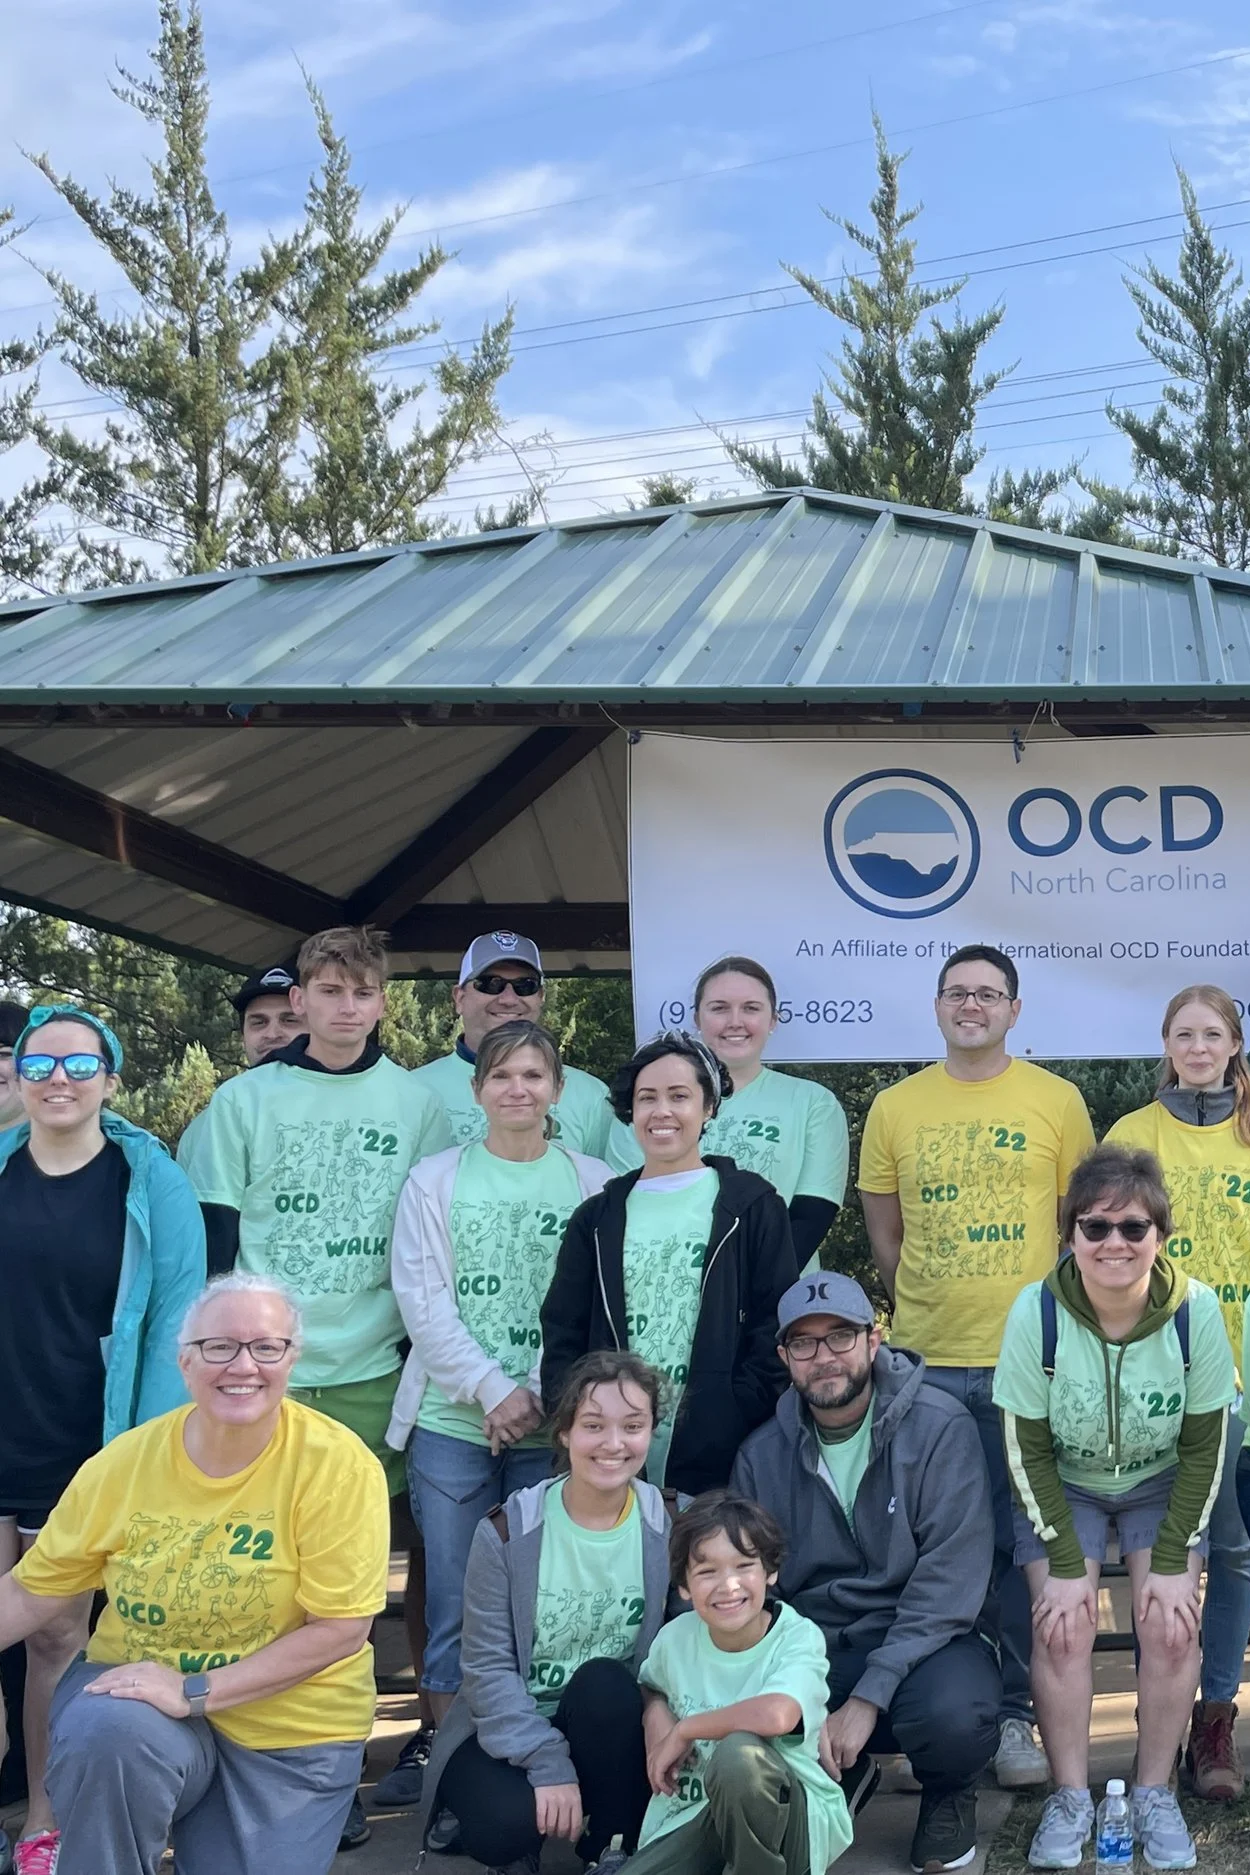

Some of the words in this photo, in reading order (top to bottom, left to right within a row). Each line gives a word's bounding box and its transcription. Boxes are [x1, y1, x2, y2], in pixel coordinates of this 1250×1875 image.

[1008, 785, 1224, 857] OCD
[1010, 868, 1095, 895] North
[1106, 865, 1228, 893] Carolina
[796, 940, 824, 957] An
[831, 939, 908, 957] Affiliate
[915, 941, 935, 957] of
[940, 941, 959, 958] th
[1110, 942, 1159, 958] OCD
[358, 1127, 398, 1156] '22
[742, 1120, 780, 1143] '22
[988, 1126, 1027, 1151] '22
[275, 1193, 320, 1213] OCD
[921, 1183, 959, 1204] OCD
[966, 1223, 1026, 1242] WALK
[325, 1236, 388, 1258] WALK
[1165, 1237, 1193, 1258] CD
[458, 1274, 501, 1296] OCD
[1140, 1391, 1182, 1418] '22
[225, 1522, 274, 1560] '22
[116, 1595, 166, 1626] OCD
[678, 1776, 703, 1801] CD
